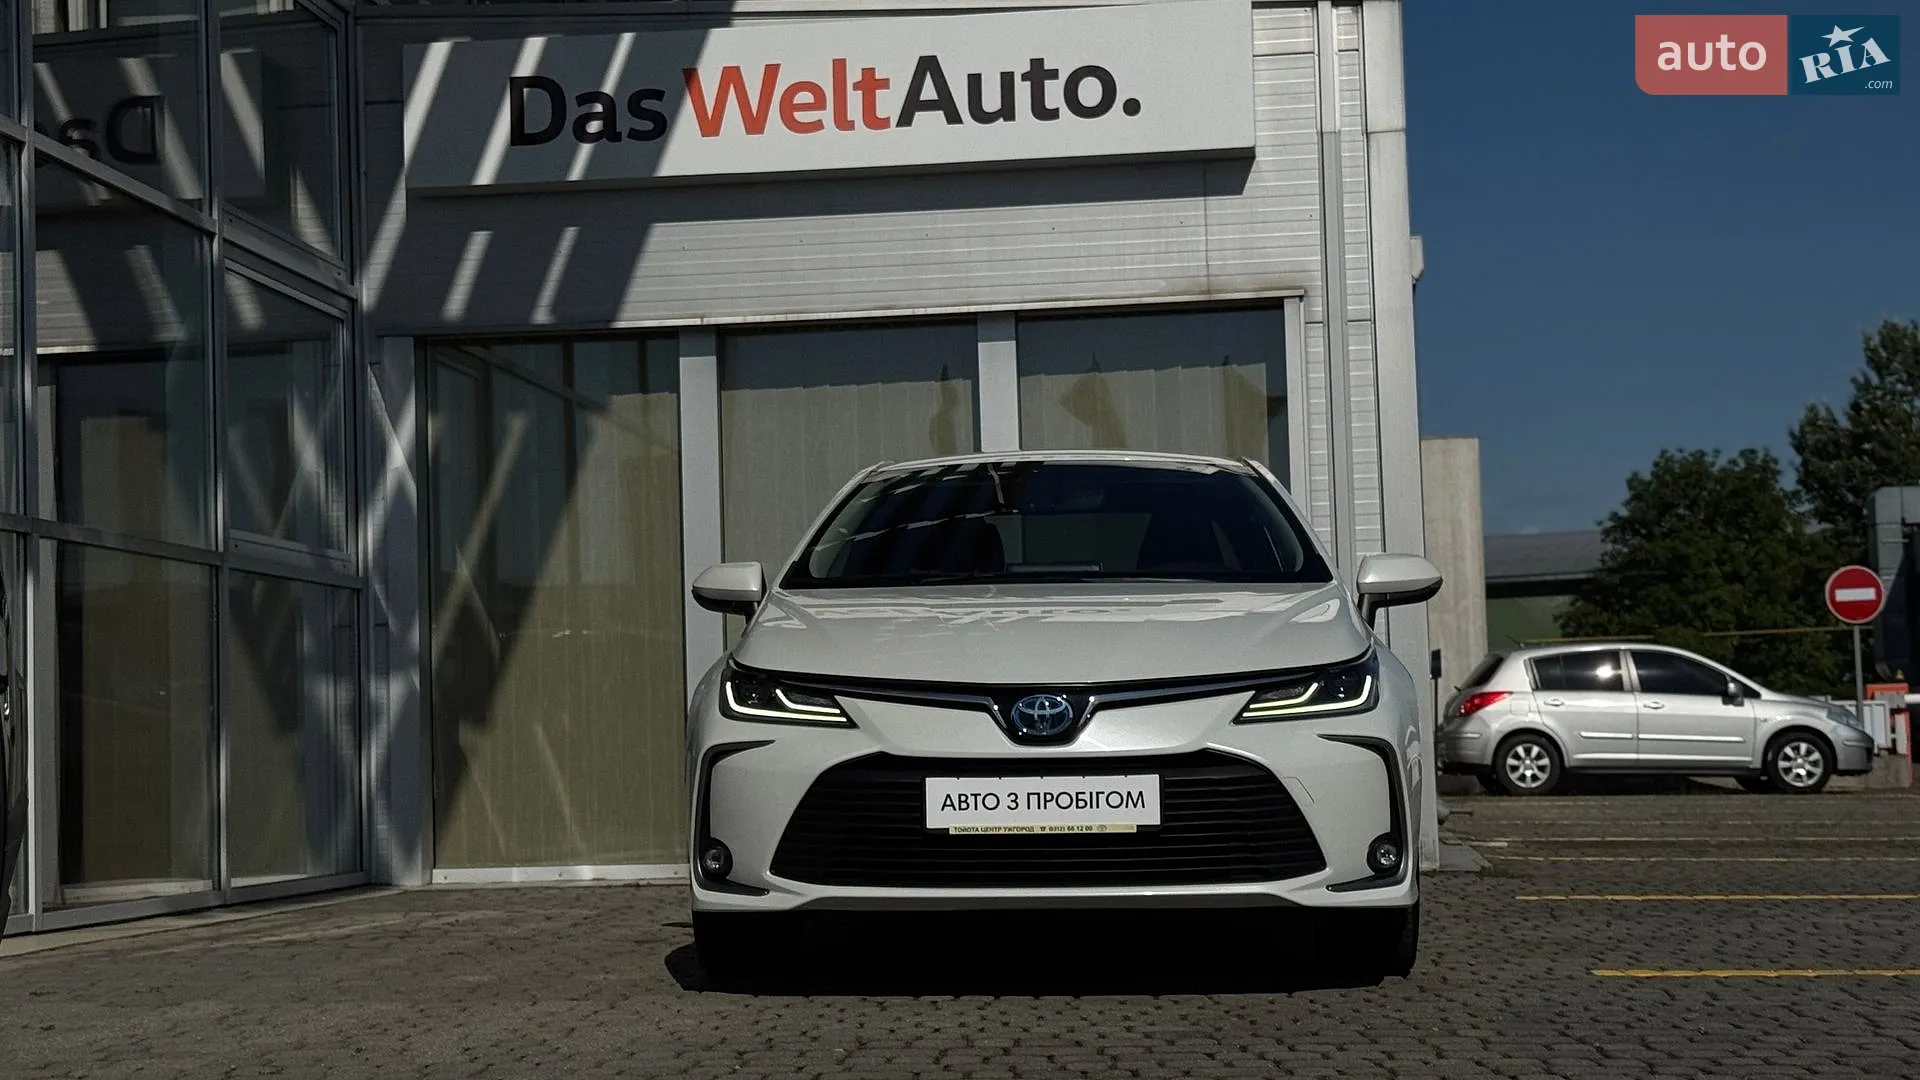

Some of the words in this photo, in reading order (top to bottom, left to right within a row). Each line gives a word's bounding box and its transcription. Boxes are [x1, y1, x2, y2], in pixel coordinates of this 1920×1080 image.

[509, 75, 668, 146] Das
[941, 792, 1000, 812] АВТО
[1007, 792, 1019, 811] З
[1027, 790, 1146, 810] ПРОБІГОМ
